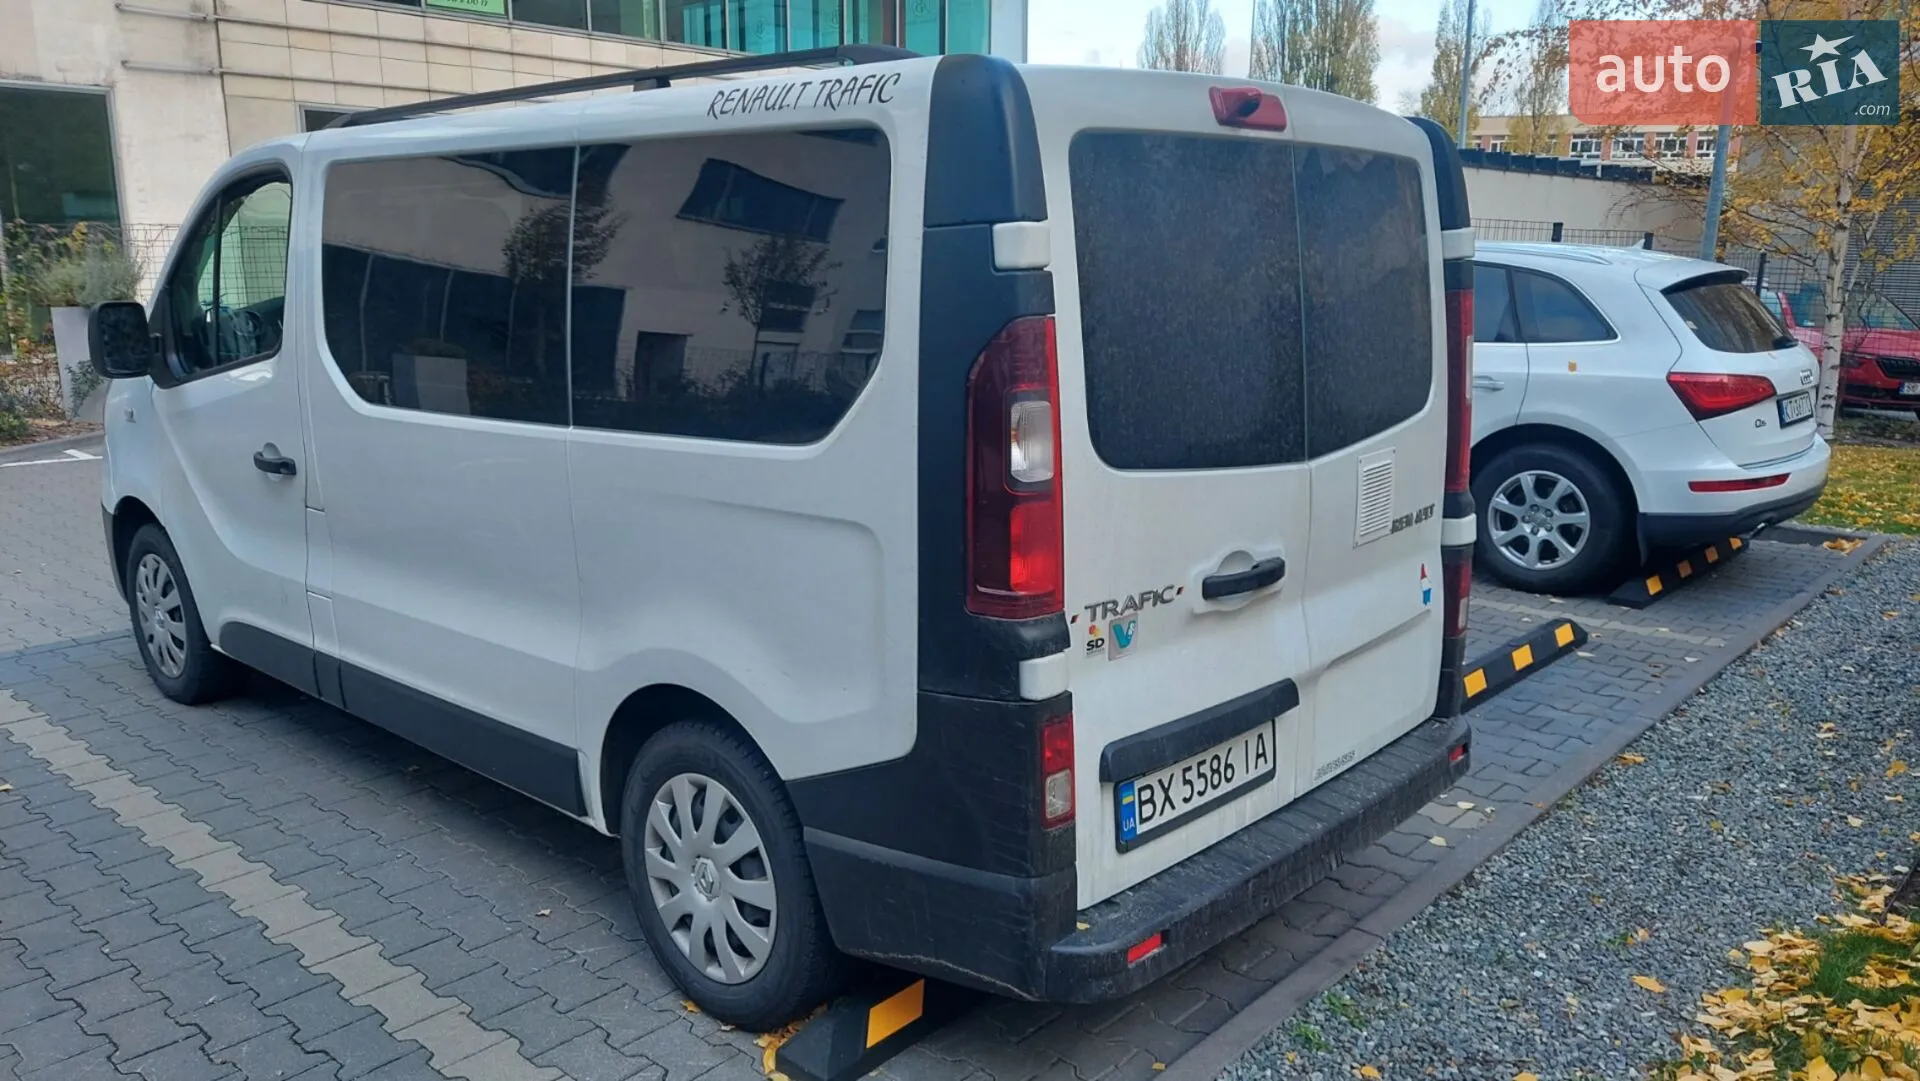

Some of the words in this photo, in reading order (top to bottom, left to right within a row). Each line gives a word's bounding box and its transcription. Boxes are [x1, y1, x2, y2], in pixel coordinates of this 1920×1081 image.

[707, 81, 813, 120] RENAULT
[813, 72, 901, 112] TRAFIC
[1084, 584, 1175, 622] TRAFIC
[1086, 637, 1105, 652] SD
[1137, 772, 1176, 825] BX
[1182, 747, 1235, 804] 5586
[1245, 732, 1268, 775] IA
[1123, 817, 1135, 832] UA
